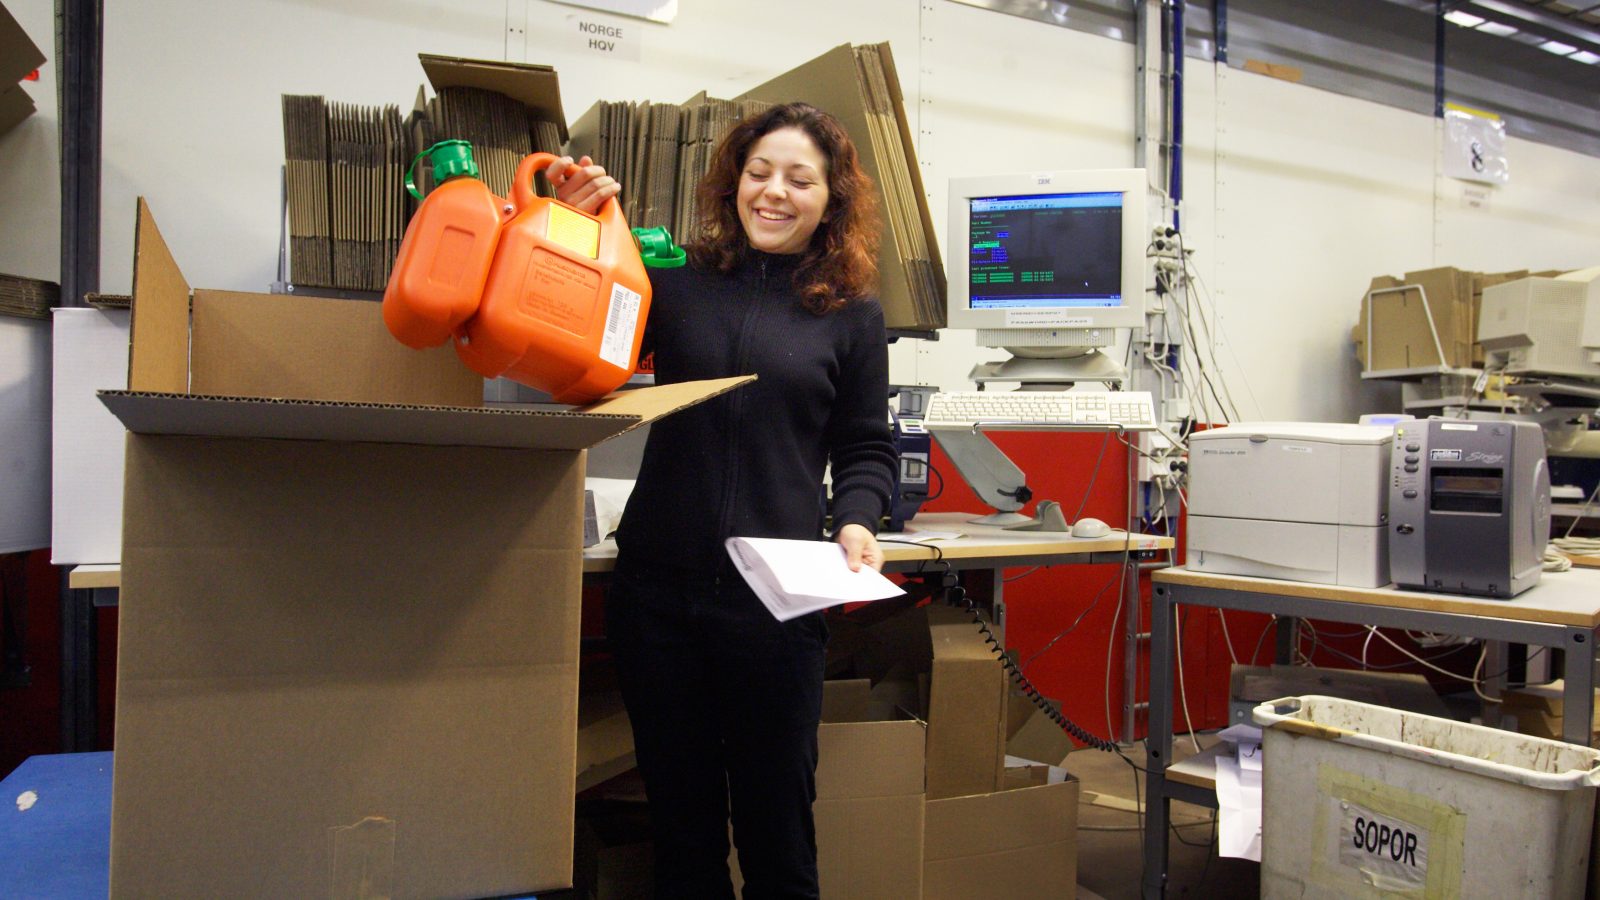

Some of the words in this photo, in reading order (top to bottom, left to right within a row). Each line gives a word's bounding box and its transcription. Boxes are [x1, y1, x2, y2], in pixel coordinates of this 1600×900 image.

[579, 21, 624, 39] NORGE
[588, 39, 615, 52] HQV
[1353, 817, 1418, 867] SOPOR
